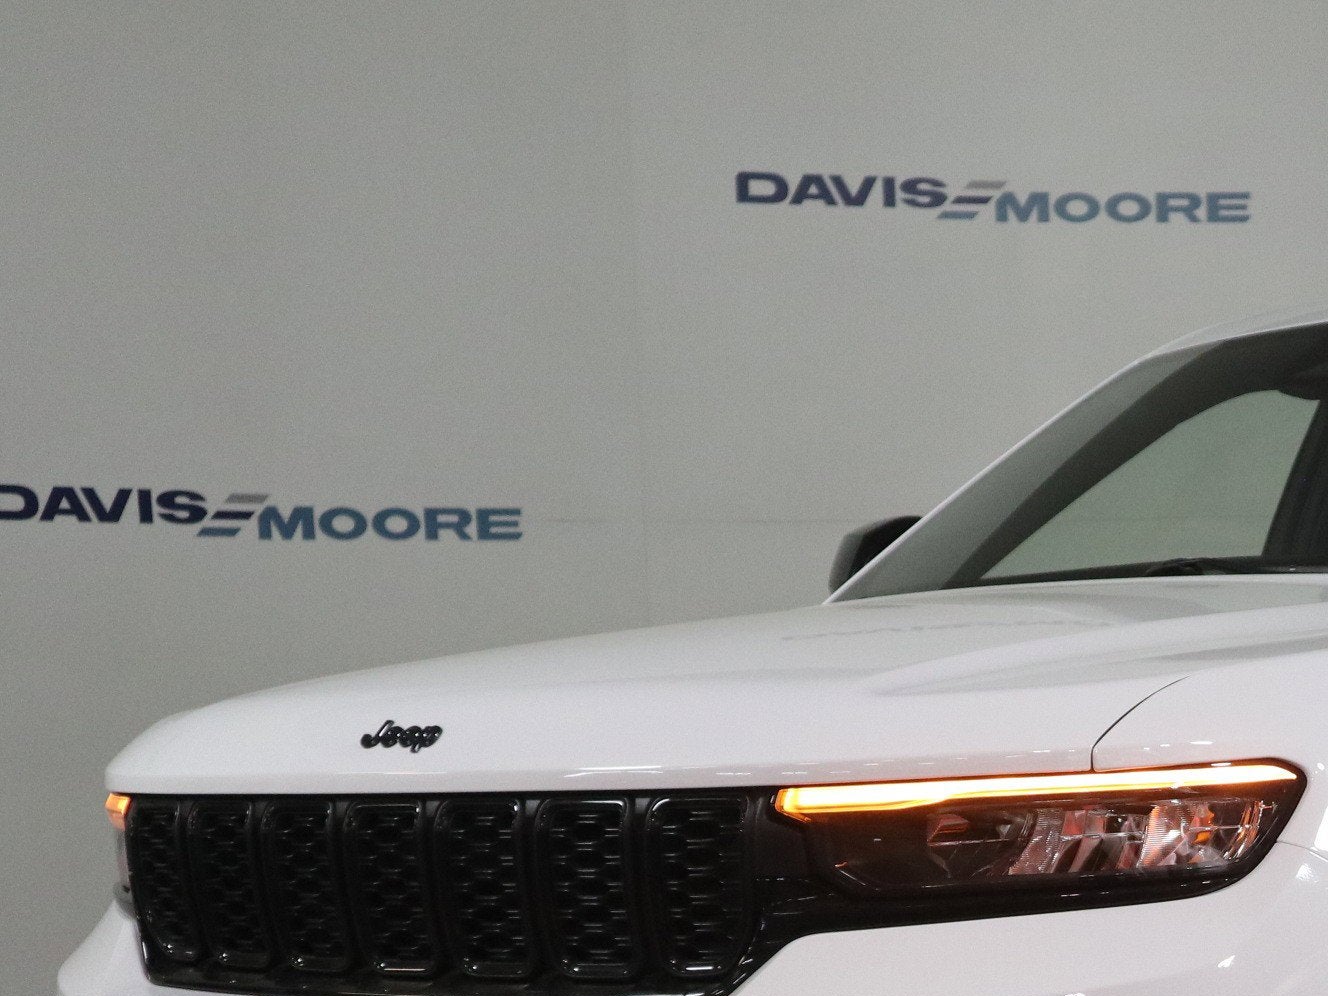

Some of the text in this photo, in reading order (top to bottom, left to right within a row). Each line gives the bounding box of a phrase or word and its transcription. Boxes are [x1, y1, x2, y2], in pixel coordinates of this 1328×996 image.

[735, 170, 1251, 223] DAVIS MOORE
[0, 484, 523, 541] DAVIS MOORE
[360, 720, 443, 753] Jeep
